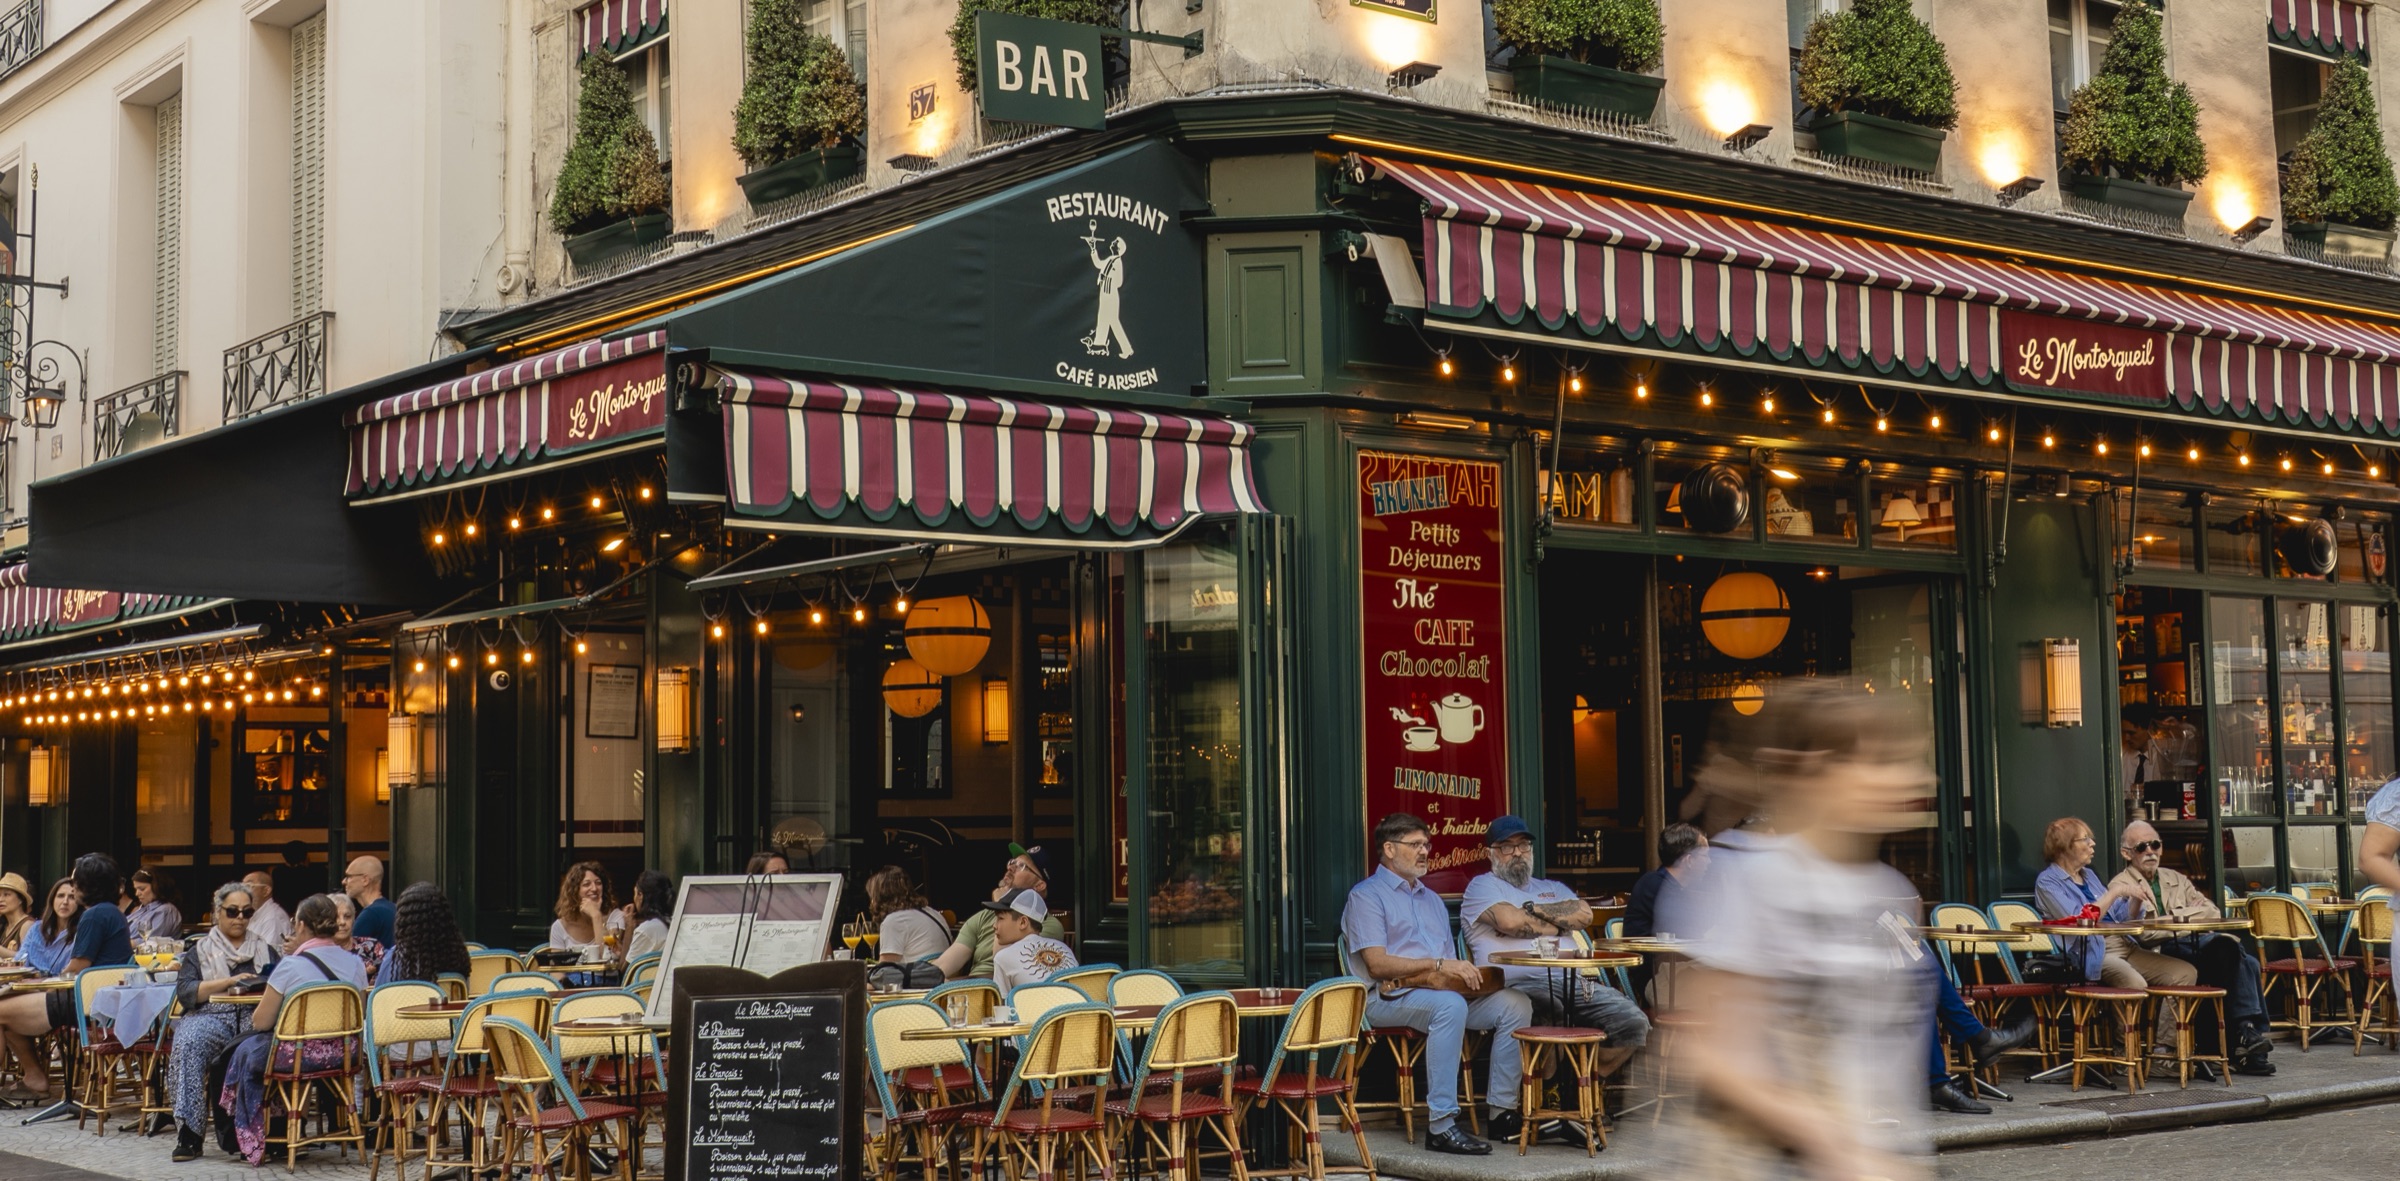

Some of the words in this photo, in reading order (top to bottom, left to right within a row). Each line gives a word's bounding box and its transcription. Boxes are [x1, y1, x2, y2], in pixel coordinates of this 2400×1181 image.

[996, 40, 1090, 101] BAR
[912, 86, 934, 118] 57
[1046, 192, 1169, 235] RESTAURANT
[1056, 361, 1094, 388] CAFÉ
[1098, 367, 1159, 390] PARISIEN
[2019, 338, 2044, 379] Le
[2045, 337, 2155, 386] Montorgueil
[568, 397, 588, 438] Le
[1371, 475, 1450, 516] BRUNCH
[1410, 520, 1460, 547] Petits
[1388, 545, 1481, 572] Déjeuners
[1393, 578, 1439, 609] Thé
[1415, 618, 1474, 646] CAFE
[1380, 650, 1490, 683] Chocolat
[1394, 767, 1481, 800] LIMONADE
[1428, 801, 1440, 813] et
[695, 1062, 707, 1079] Le
[709, 1082, 740, 1097] Boisson
[693, 1126, 706, 1143] Le
[710, 1148, 742, 1162] Boisson
